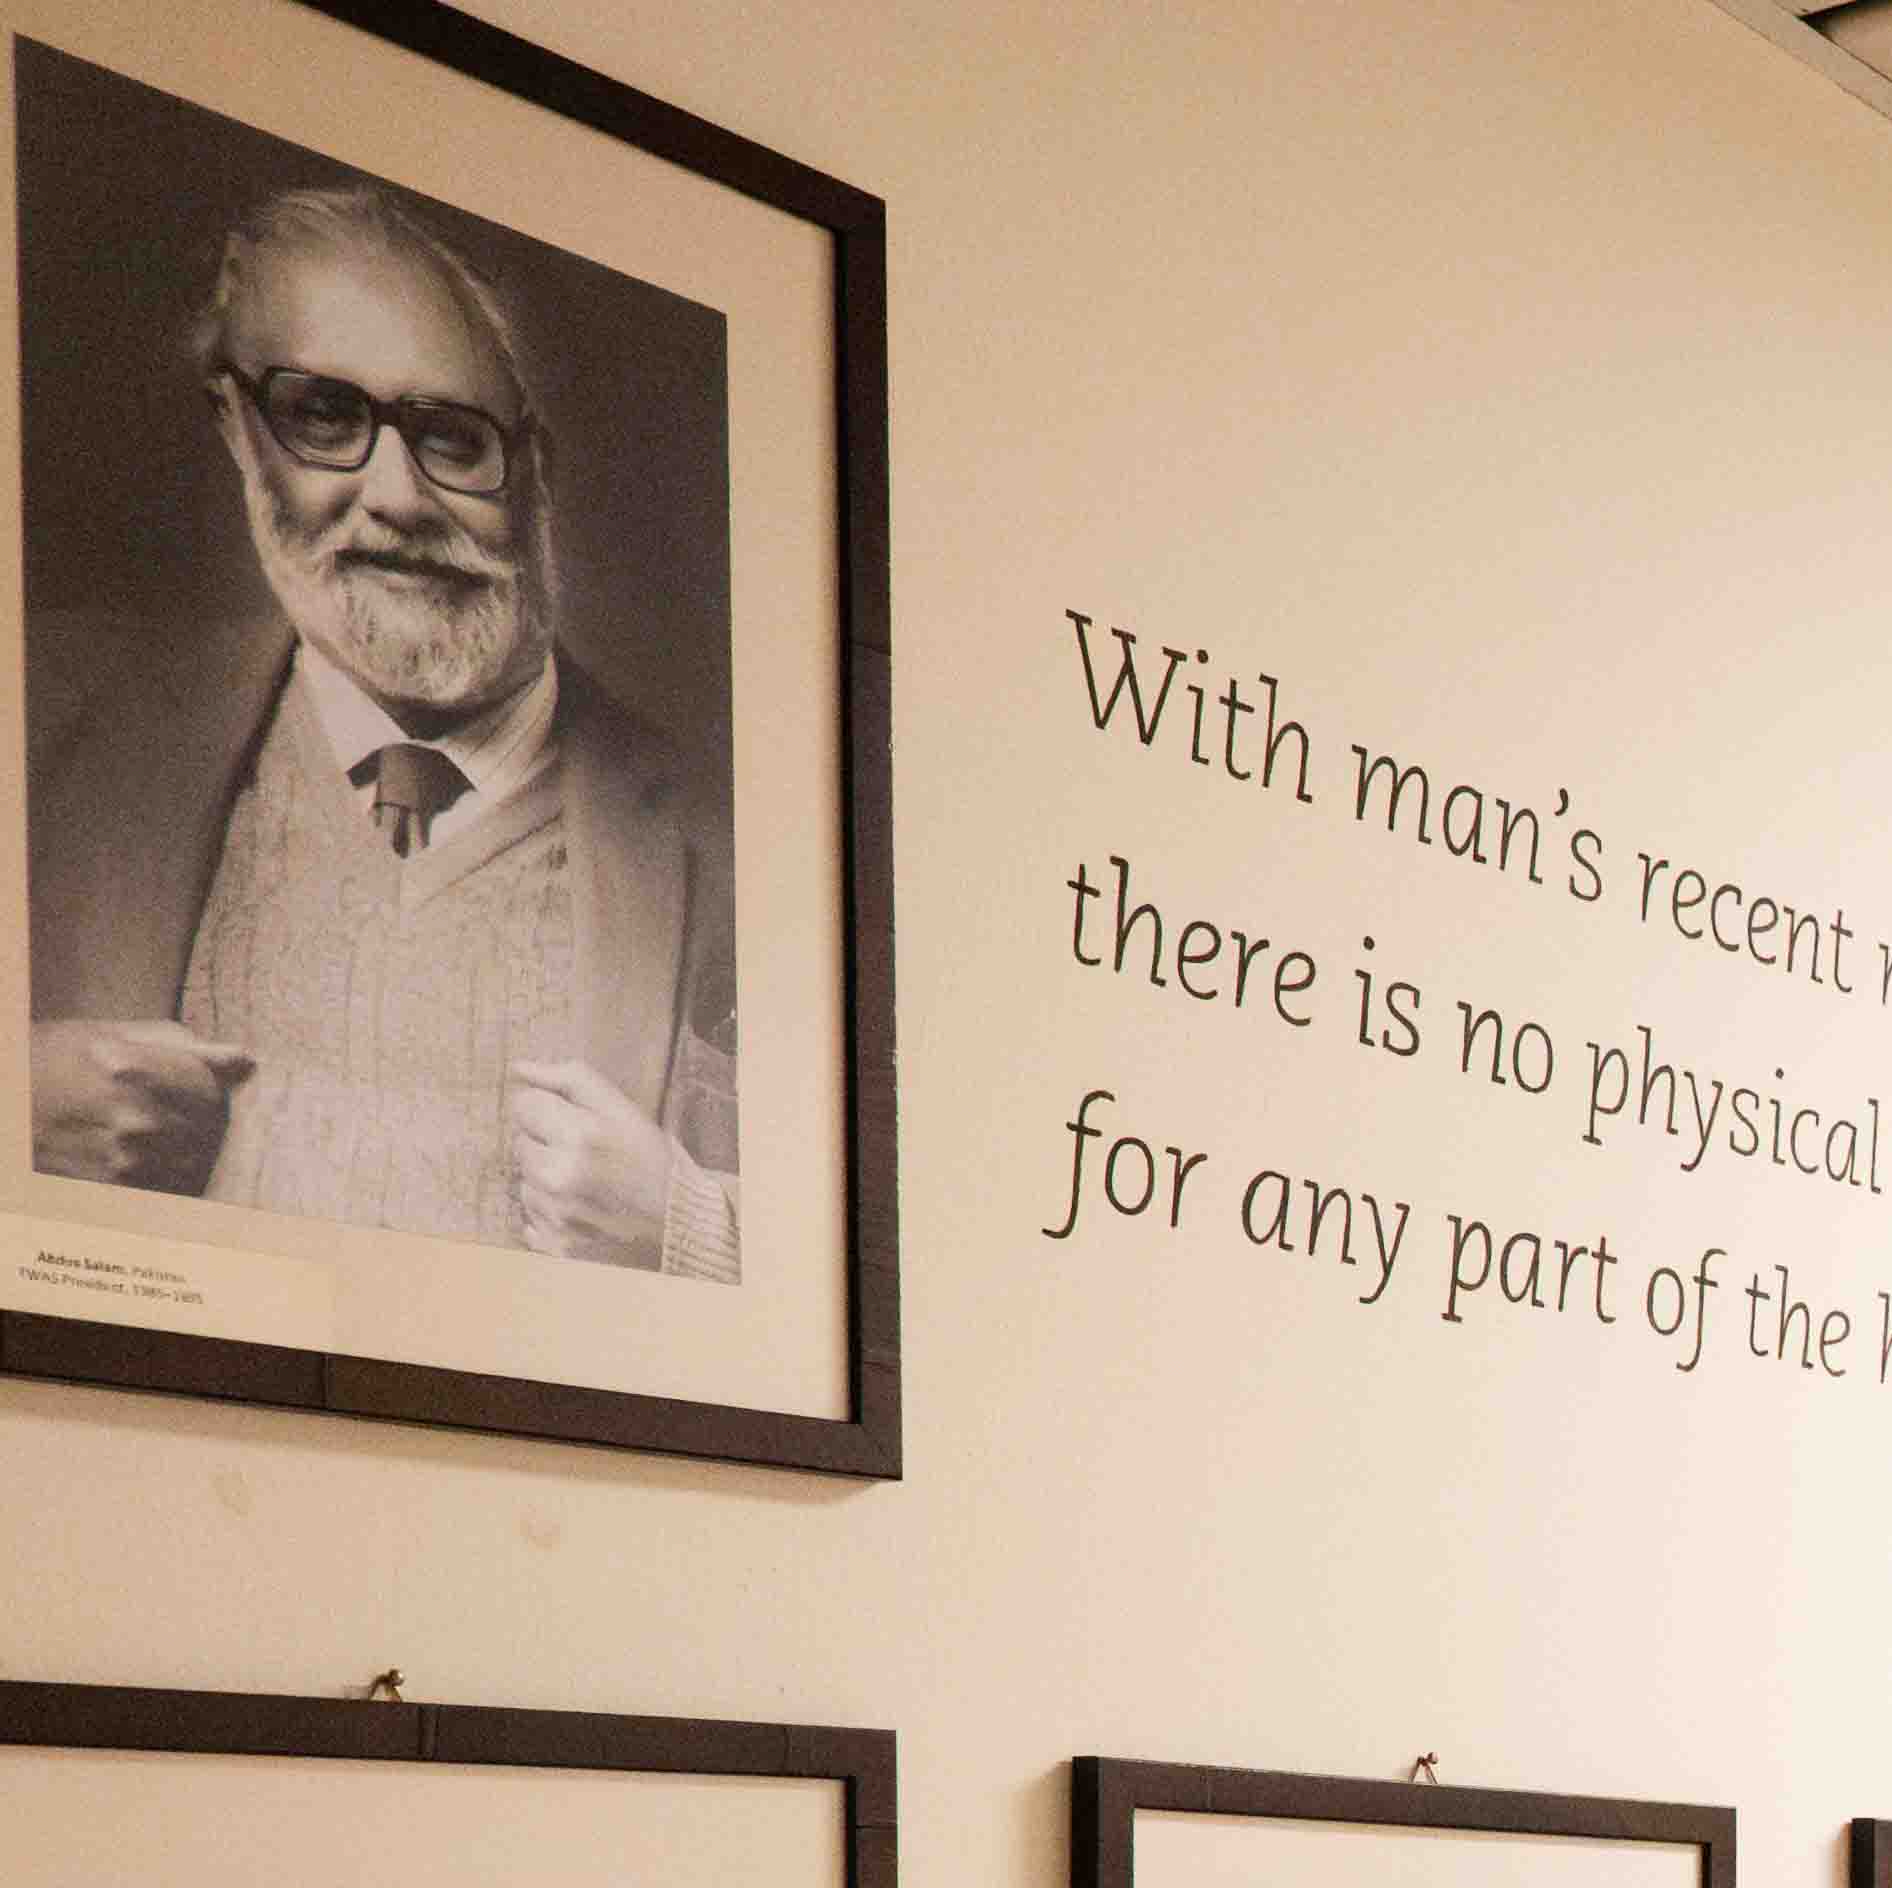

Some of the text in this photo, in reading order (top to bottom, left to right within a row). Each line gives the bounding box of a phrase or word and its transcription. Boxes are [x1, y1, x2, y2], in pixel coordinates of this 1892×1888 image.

[1066, 609, 1312, 802] With
[1352, 744, 1602, 902] man's
[1638, 852, 1853, 994] recent
[1067, 856, 1316, 1025] there
[1355, 937, 1422, 1055] is
[1458, 999, 1554, 1093] no
[1583, 1026, 1881, 1194] physical
[1042, 1091, 1208, 1238] for
[1241, 1170, 1409, 1304] any
[1442, 1214, 1617, 1323] part
[1647, 1249, 1727, 1370] of
[1746, 1266, 1850, 1376] the
